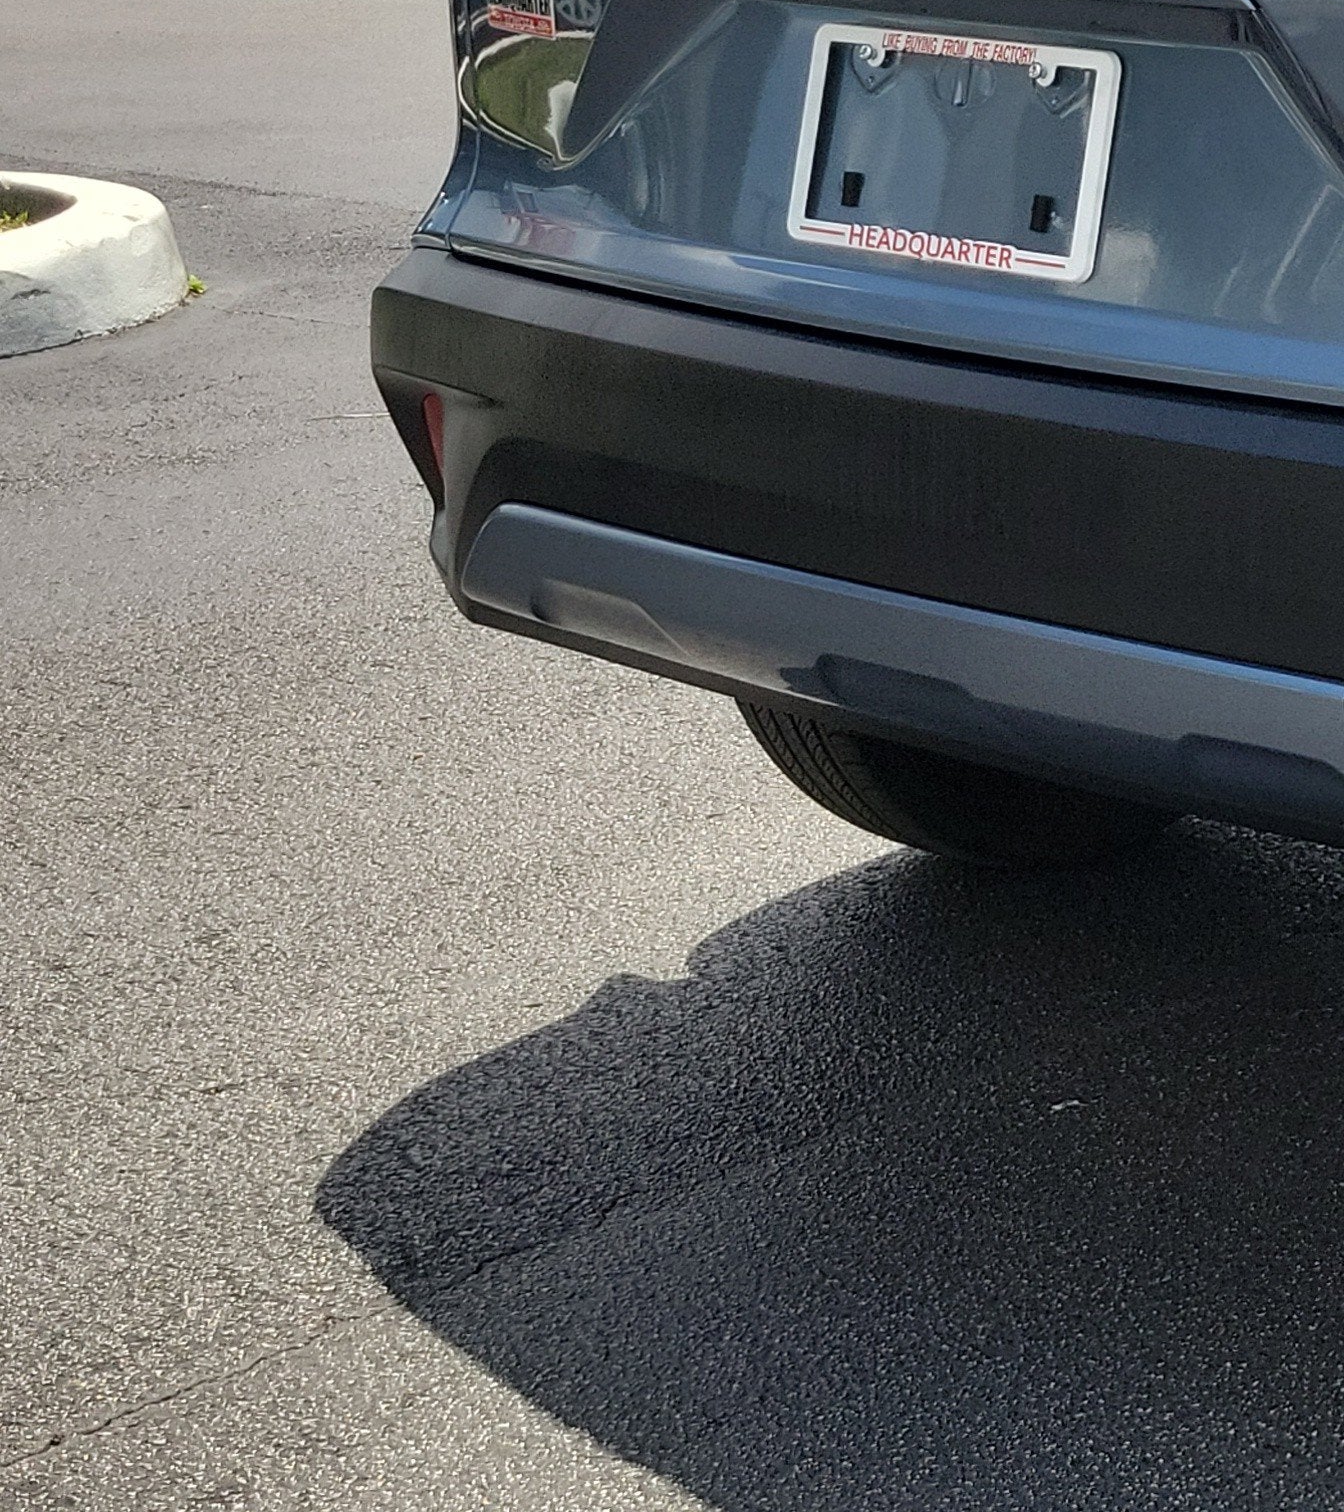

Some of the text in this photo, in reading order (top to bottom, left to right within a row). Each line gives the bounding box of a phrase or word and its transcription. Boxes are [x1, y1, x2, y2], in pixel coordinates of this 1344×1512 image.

[882, 33, 902, 49] LIKE
[905, 35, 937, 54] BUYING
[942, 39, 968, 57] FROM
[973, 42, 989, 59] THE
[848, 225, 1013, 269] HEADQUARTER
